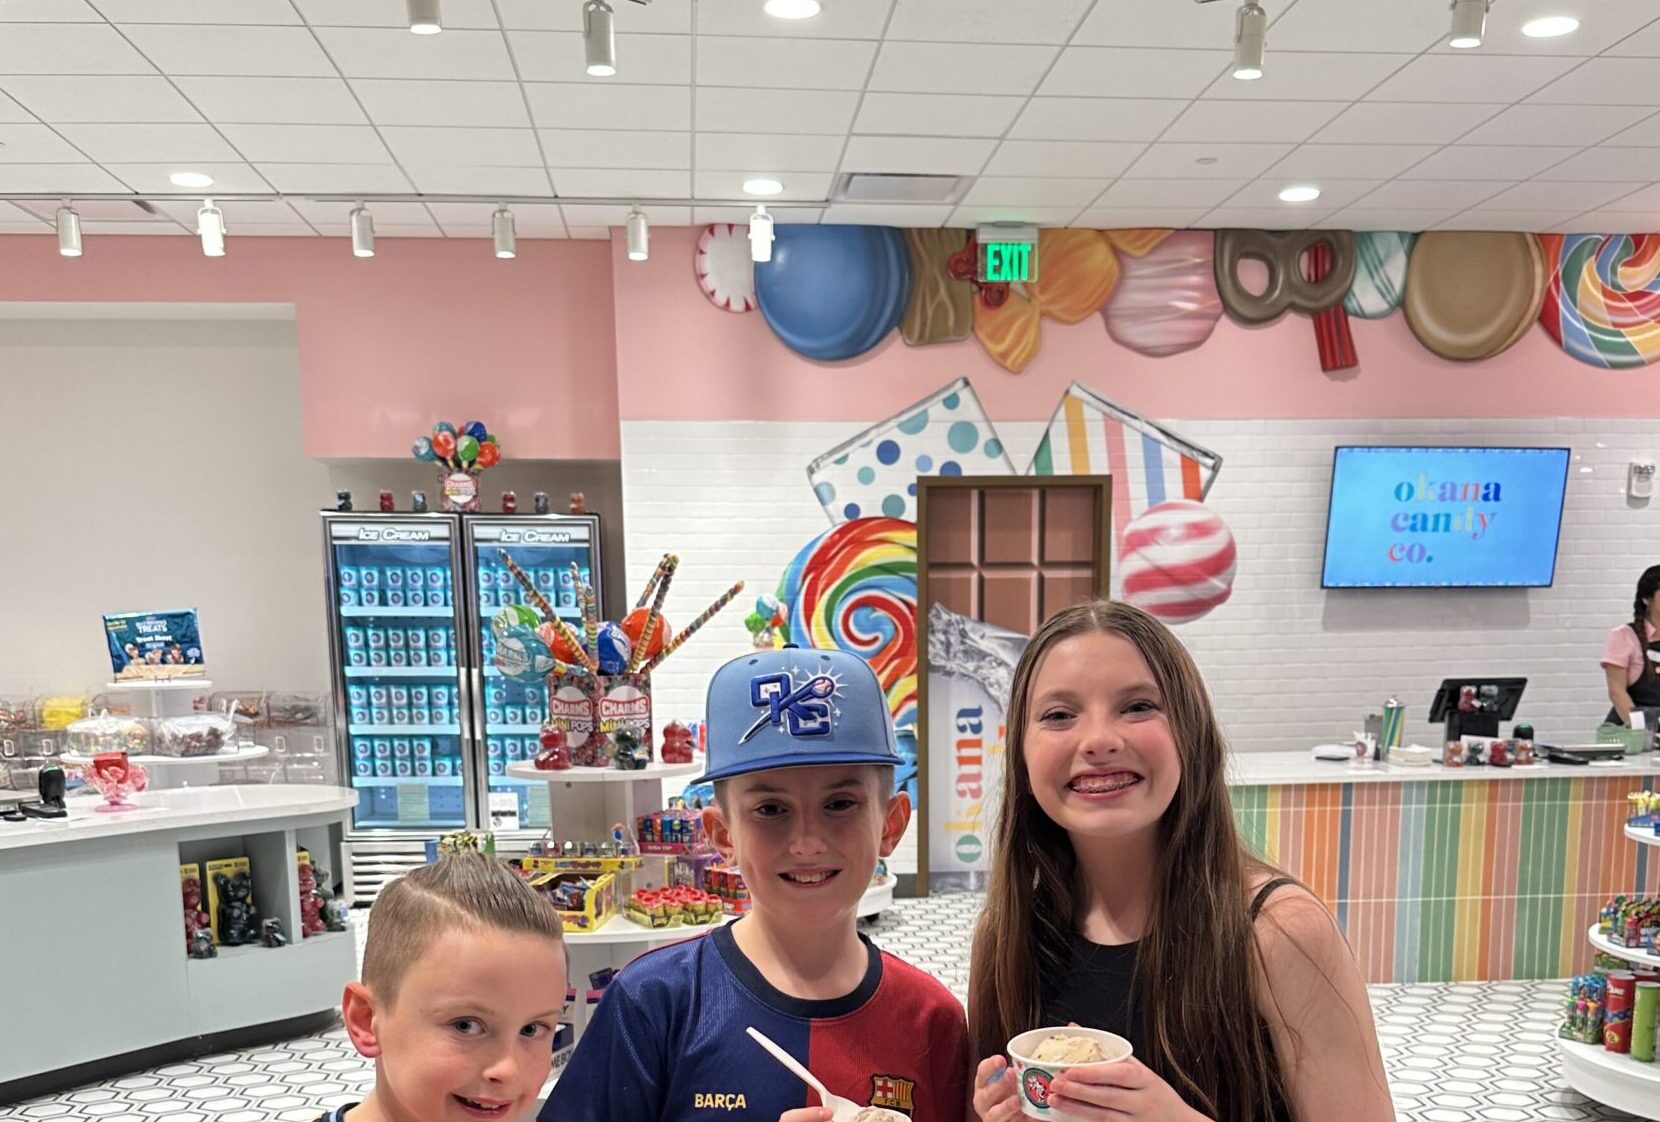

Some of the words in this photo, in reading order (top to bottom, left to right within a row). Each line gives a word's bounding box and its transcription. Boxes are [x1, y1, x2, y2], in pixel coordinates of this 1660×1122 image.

[986, 243, 1032, 282] EXIT
[1394, 472, 1502, 502] okana
[1390, 506, 1499, 541] candy
[358, 527, 379, 541] ICE
[383, 528, 430, 542] CREAM
[501, 530, 520, 543] ICE
[524, 530, 570, 543] CREAM
[1388, 542, 1434, 564] co.
[552, 699, 590, 716] CHARMS
[601, 697, 647, 716] CHARMS
[571, 719, 594, 733] POPS
[694, 1092, 747, 1112] BARÇA
